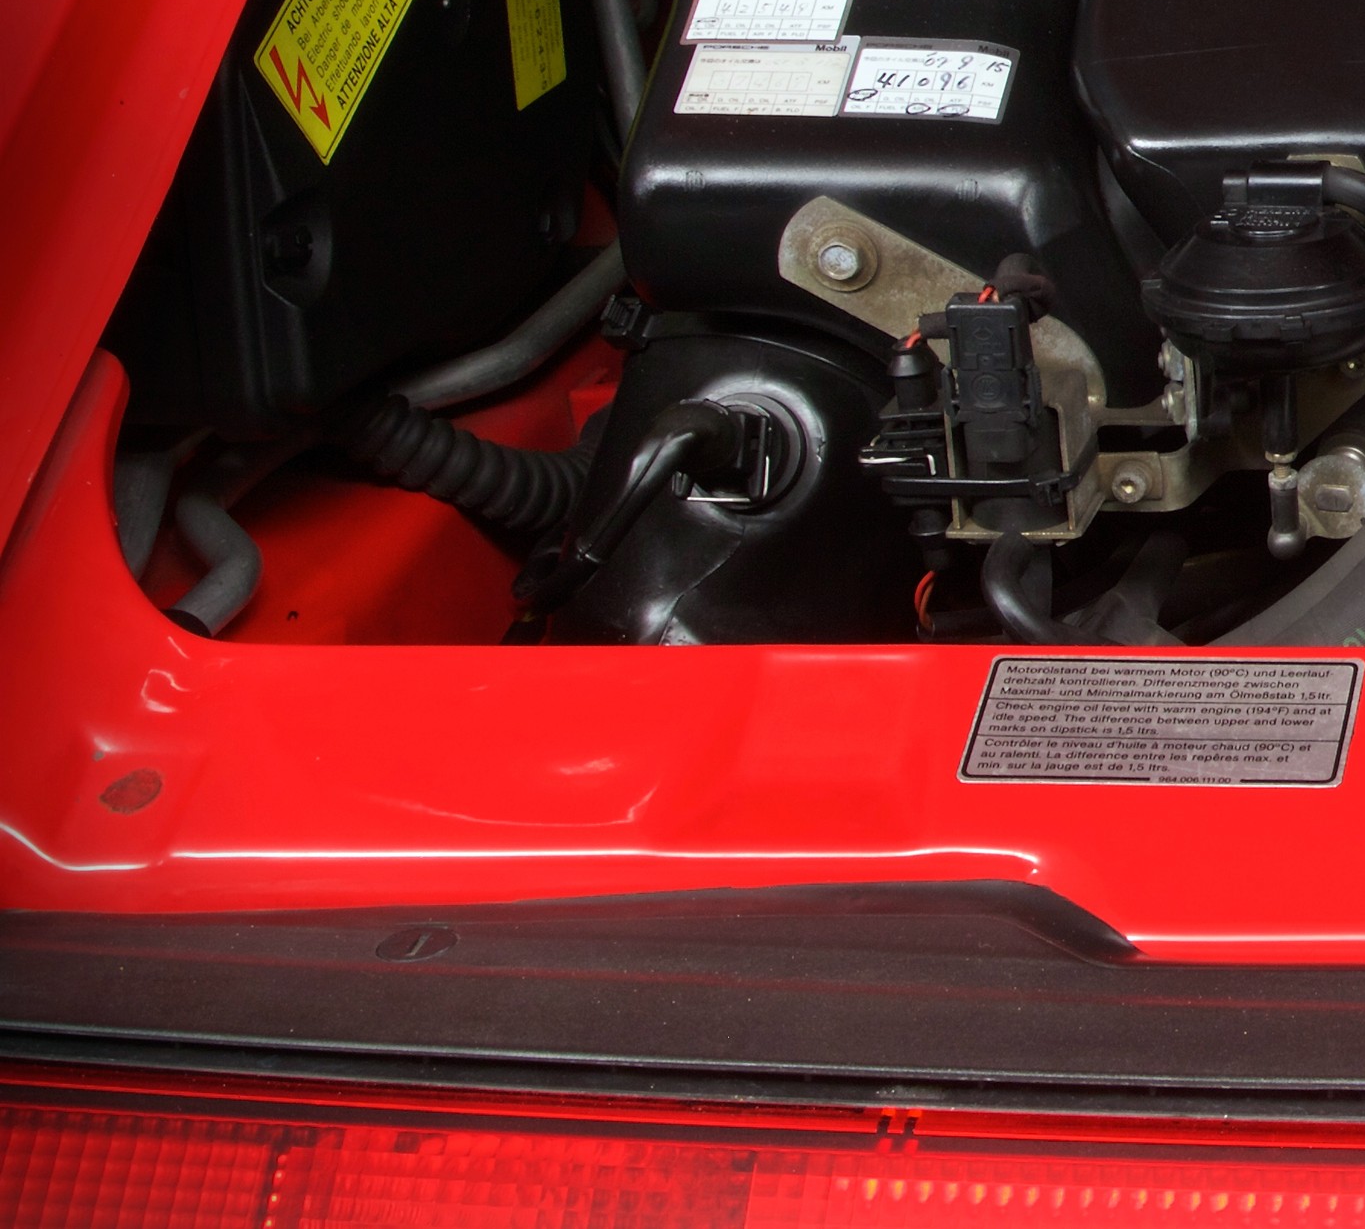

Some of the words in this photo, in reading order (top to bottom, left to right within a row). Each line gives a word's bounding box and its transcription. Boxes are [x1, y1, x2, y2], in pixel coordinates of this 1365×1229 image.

[296, 26, 312, 52] Bei
[306, 19, 333, 66] Electric
[315, 33, 342, 82] Danger
[338, 14, 351, 36] de
[815, 44, 847, 52] Mobil
[977, 44, 1010, 57] Mobil
[335, 27, 380, 110] ATTENZIONE
[1005, 666, 1087, 674] Motorölstand
[1279, 669, 1334, 677] Leerlauf-
[1059, 677, 1139, 686] kontrollieren.
[1142, 679, 1239, 688] Differenzmenge
[1243, 680, 1299, 688] zwischen
[999, 687, 1055, 695] Maximal-
[1059, 688, 1082, 696] und
[1086, 688, 1202, 699] Minimalmarkierung
[1228, 690, 1296, 699] Ölmeßstab
[994, 702, 1034, 710] Check
[1037, 704, 1080, 712] engine
[1101, 704, 1130, 712] level
[1133, 704, 1159, 712] with
[1200, 706, 1242, 715] engine
[991, 713, 1014, 721] idle
[1063, 714, 1086, 722] The
[1090, 715, 1152, 723] difference
[1156, 716, 1210, 724] between
[1253, 717, 1277, 725] and
[988, 724, 1026, 732] marks
[1049, 725, 1098, 734] dipstick
[1116, 727, 1134, 735] 1,5
[983, 738, 1043, 747] Contrôler
[1062, 740, 1102, 748] niveau
[1106, 740, 1147, 749] d'huile
[999, 750, 1042, 758] ralenti.
[1044, 762, 1080, 771] jauge
[1128, 764, 1144, 772] 1,5
